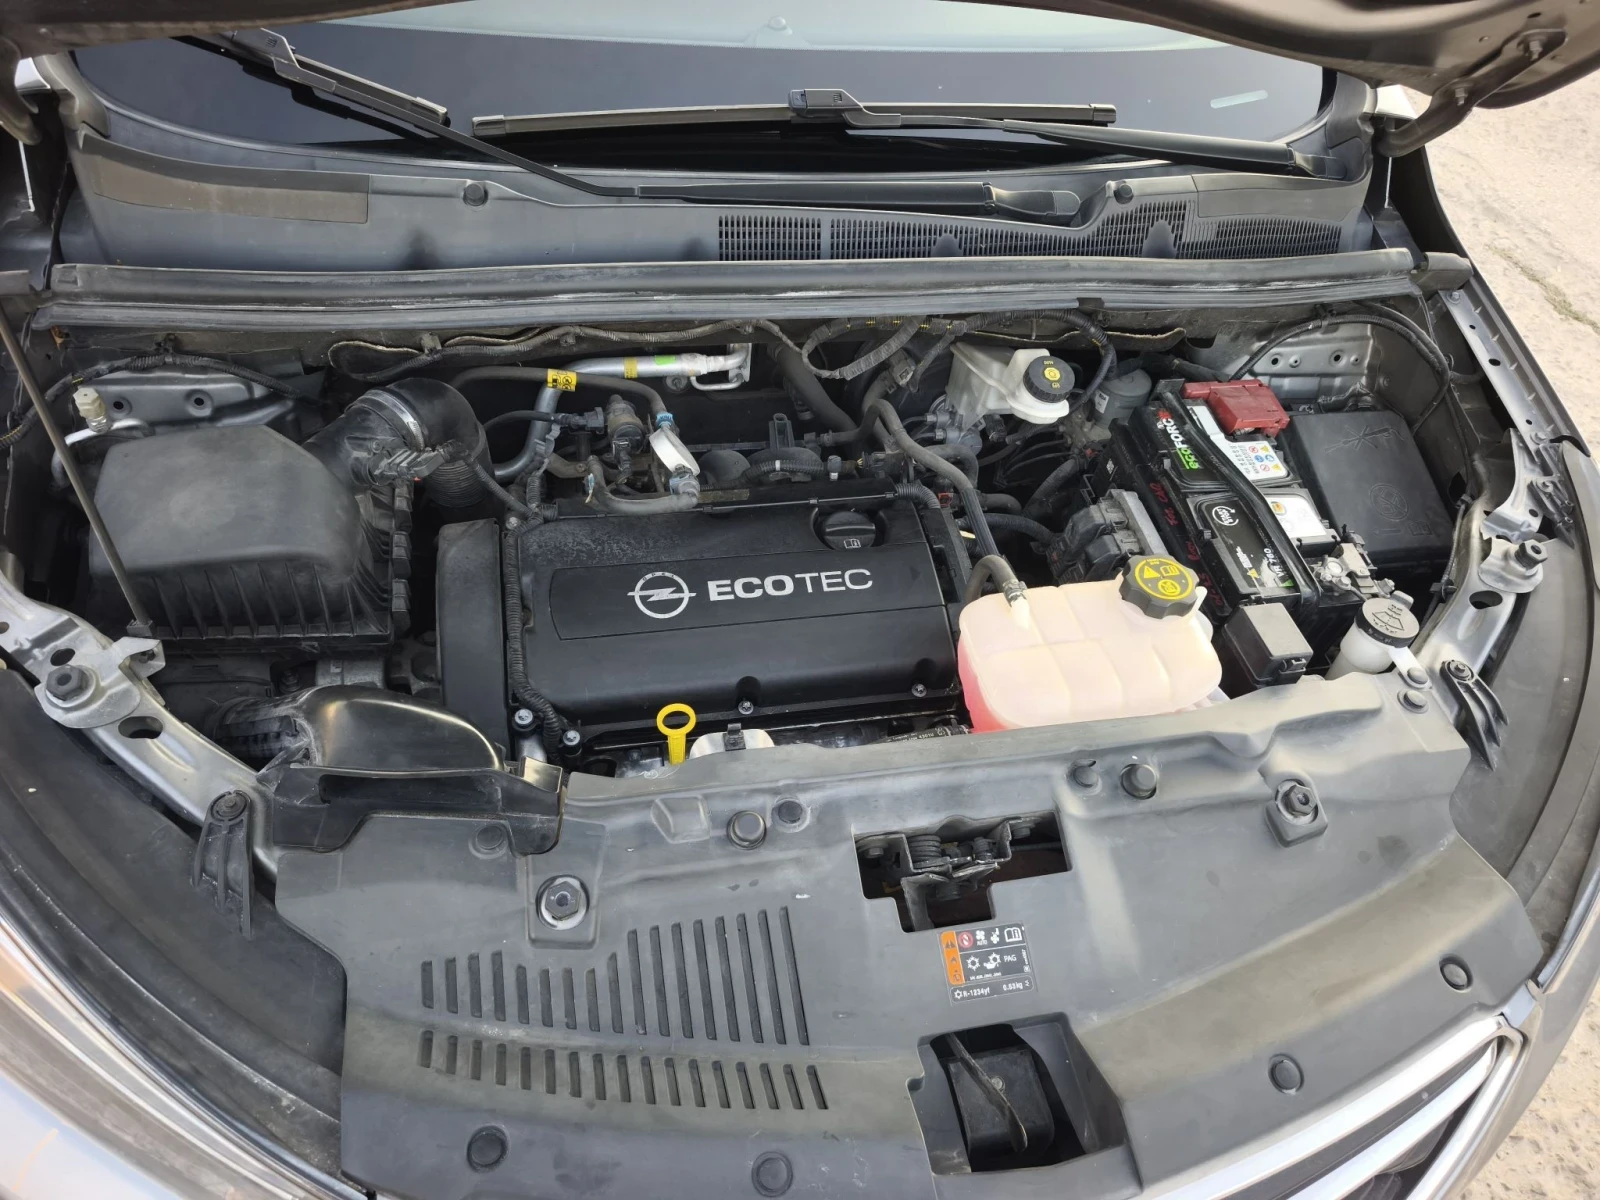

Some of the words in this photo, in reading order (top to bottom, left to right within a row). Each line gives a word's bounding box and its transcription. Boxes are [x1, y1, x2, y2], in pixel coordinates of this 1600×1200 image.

[1157, 408, 1200, 469] ecoFORC
[707, 568, 873, 601] ECOTEC
[1003, 954, 1017, 963] PAG
[963, 986, 990, 998] R-1234yf
